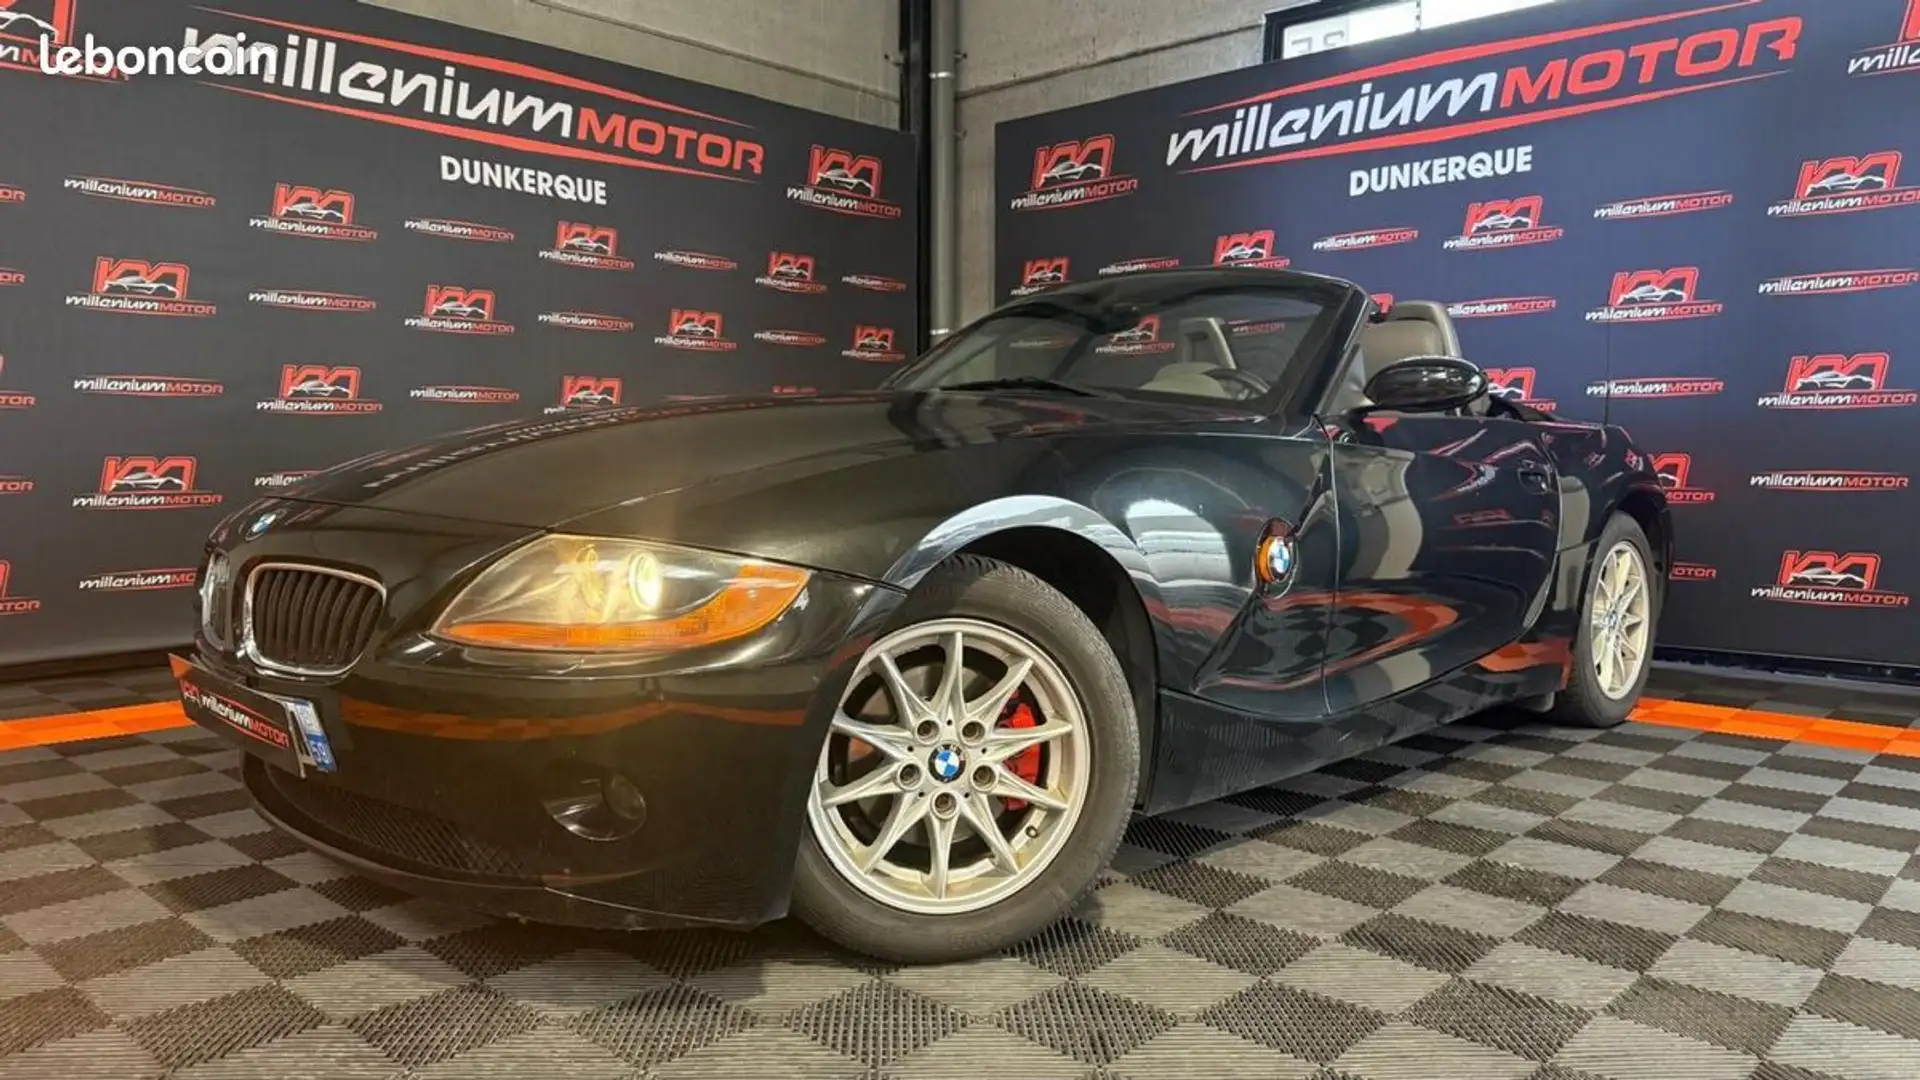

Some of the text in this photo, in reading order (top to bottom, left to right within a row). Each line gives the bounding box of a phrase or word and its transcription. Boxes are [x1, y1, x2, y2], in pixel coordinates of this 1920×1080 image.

[1166, 16, 1803, 167] milleniumMOTOR
[440, 155, 607, 205] DUNKERQUE
[1349, 145, 1533, 197] DUNKERQUE
